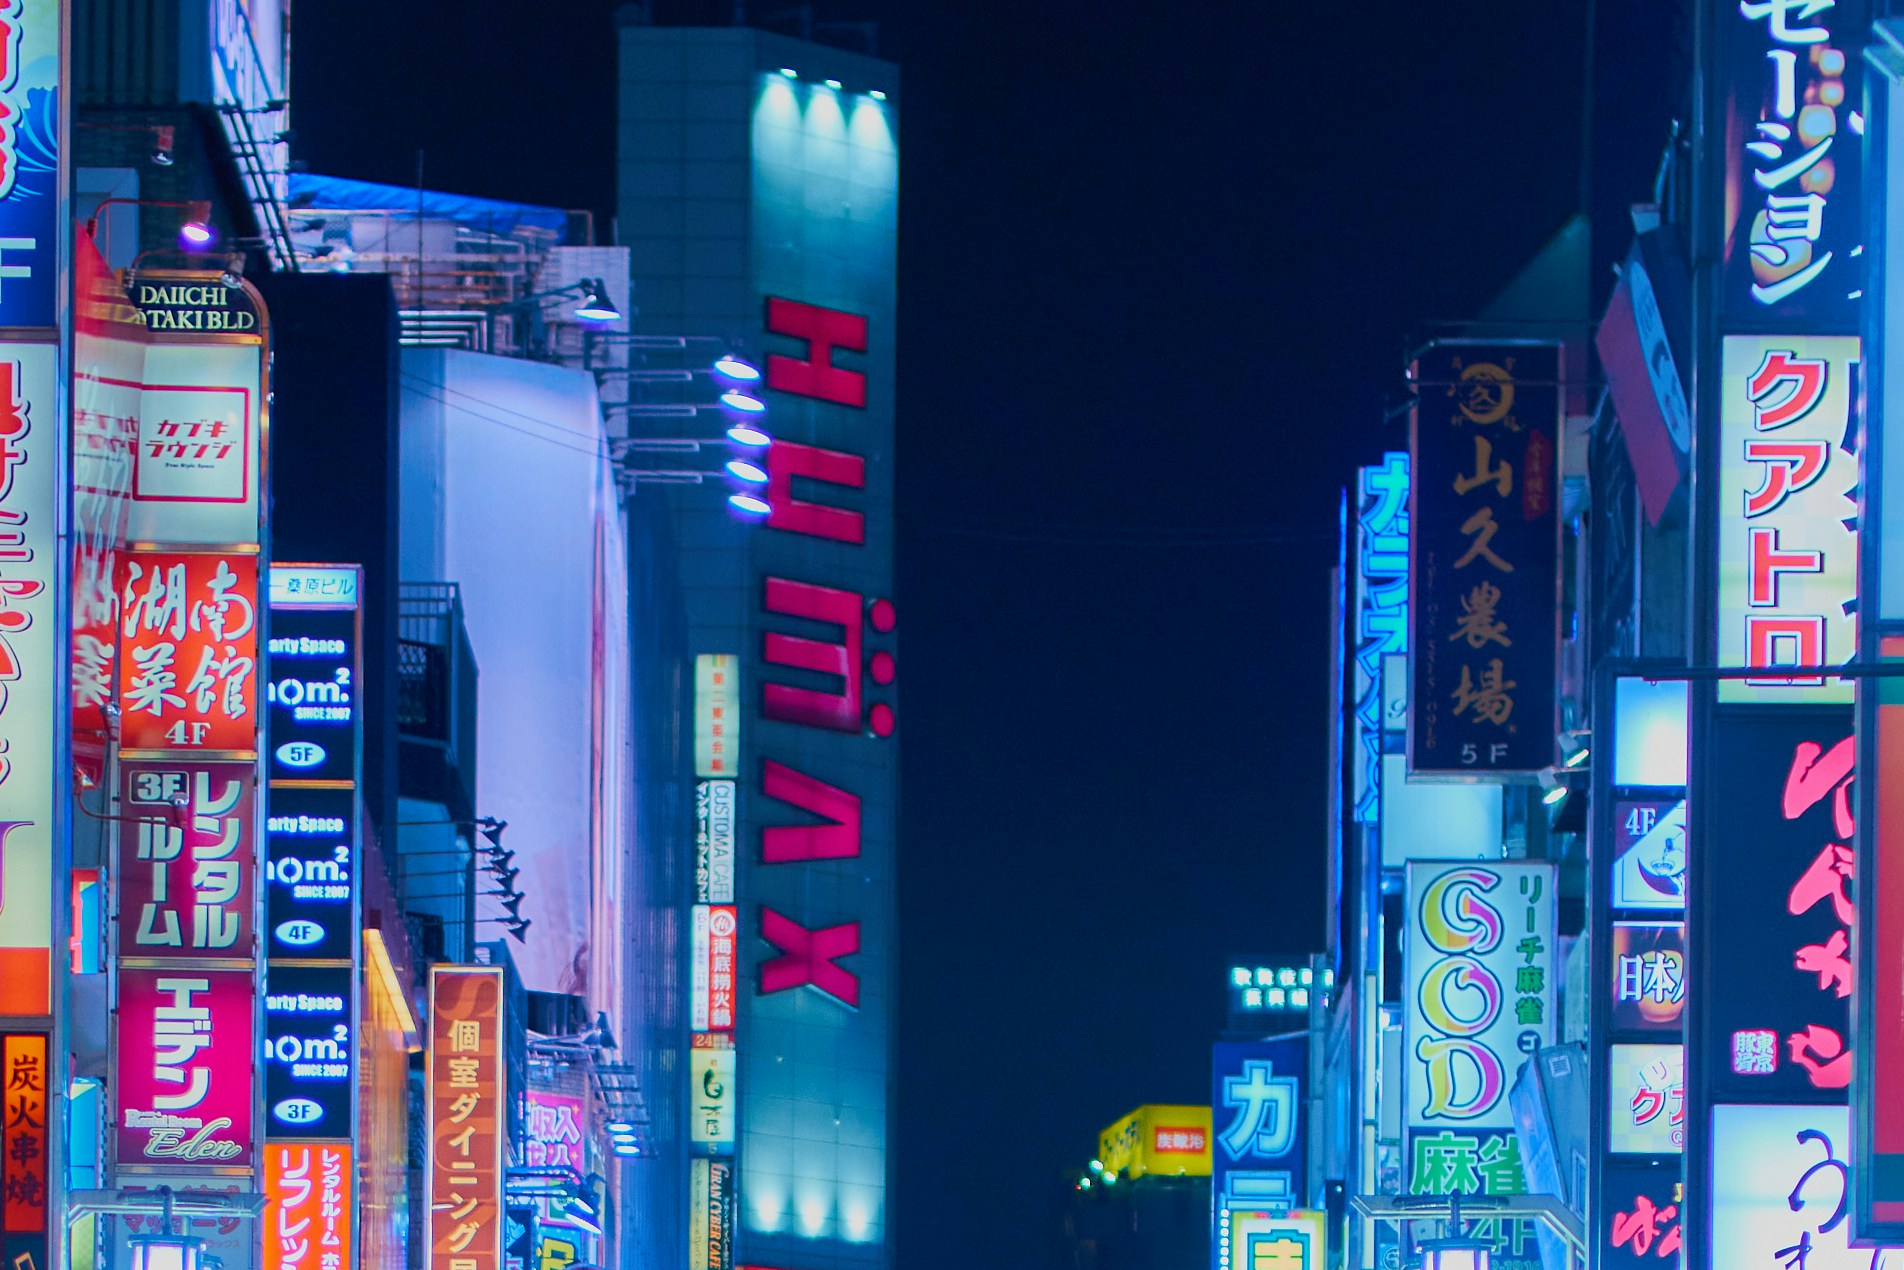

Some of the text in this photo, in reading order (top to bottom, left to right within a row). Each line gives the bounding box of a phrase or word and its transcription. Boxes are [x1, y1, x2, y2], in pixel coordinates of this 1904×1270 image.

[140, 286, 228, 306] DAIICHI
[206, 310, 254, 330] BLD
[157, 419, 230, 438] カブキ
[145, 440, 237, 460] ラウンジ
[1744, 350, 1828, 688] クアトロ
[1448, 435, 1518, 727] 山久農場
[125, 562, 253, 641] 湖南
[124, 642, 253, 719] 菜館
[164, 720, 212, 746] 4F
[289, 746, 314, 762] 5F
[1459, 743, 1509, 765] 5F
[1625, 807, 1656, 833] 4F
[196, 773, 240, 949] レンタル
[137, 817, 183, 947] ルーム
[288, 925, 313, 941] 4F
[1515, 875, 1546, 1027] リーチ麻雀
[1418, 866, 1504, 1122] GOD
[153, 978, 210, 1110] エデン
[5, 1055, 43, 1206] 炭火串焼
[287, 1103, 312, 1119] 3F
[144, 1116, 243, 1161] Eden
[321, 1149, 342, 1246] レンタルルーム
[708, 1202, 724, 1238] CYBER
[708, 1239, 722, 1270] CAFE
